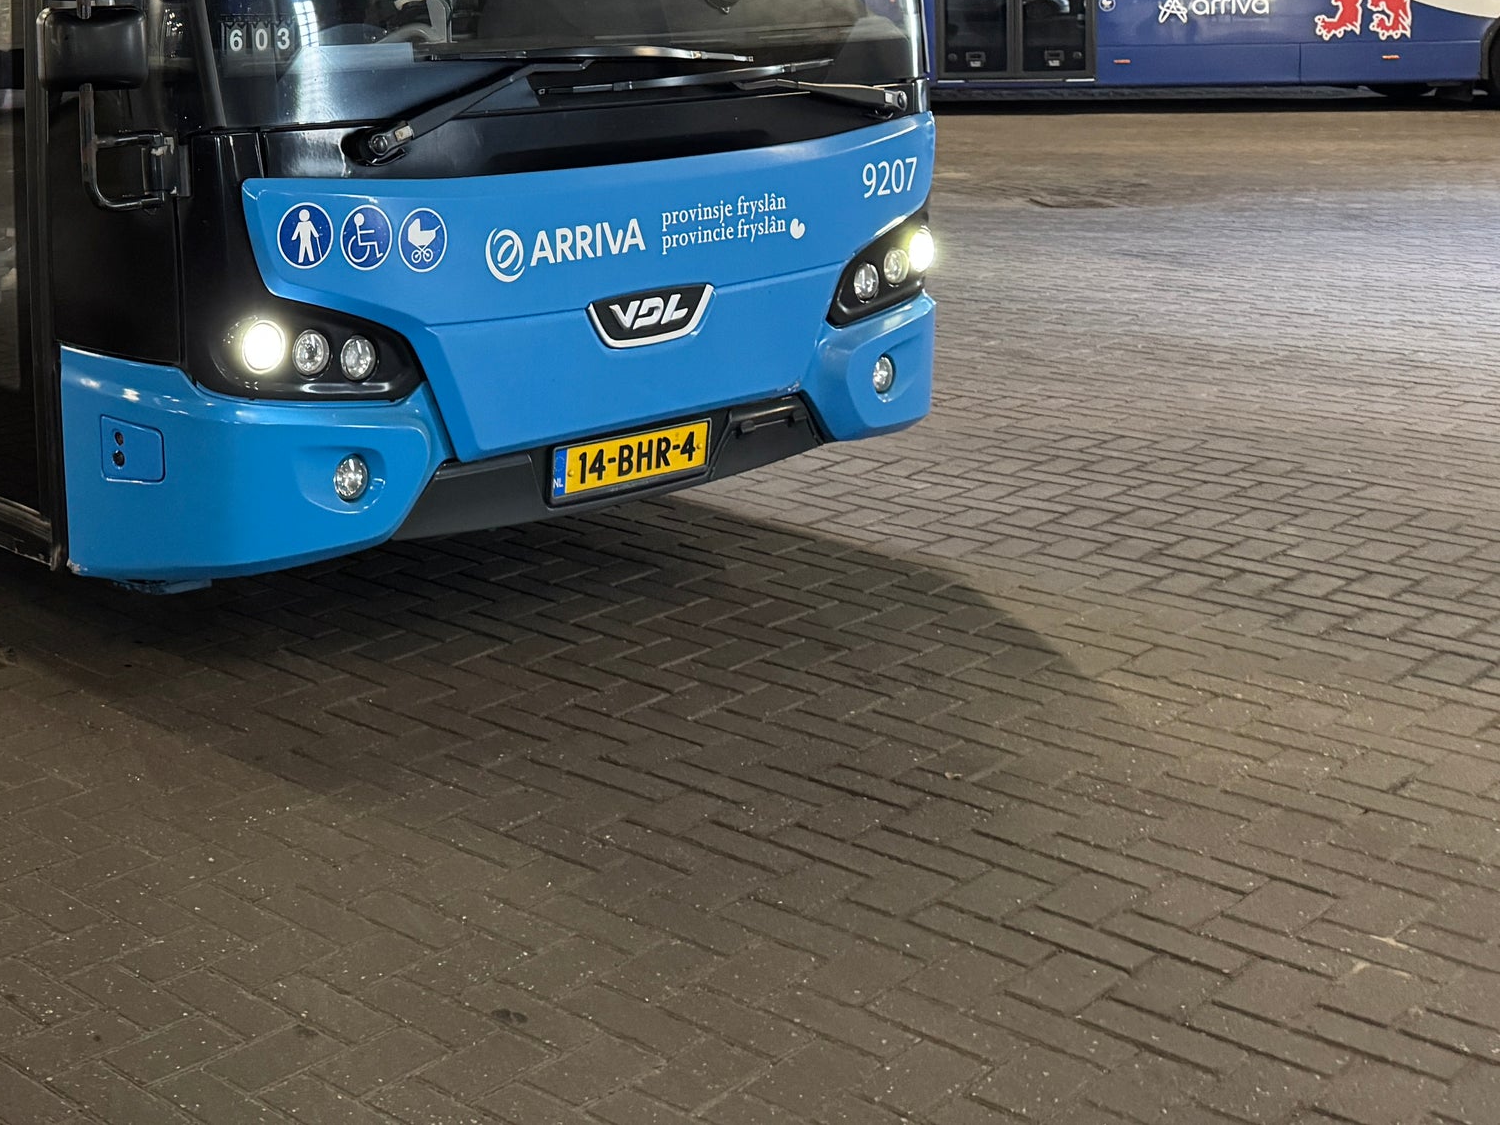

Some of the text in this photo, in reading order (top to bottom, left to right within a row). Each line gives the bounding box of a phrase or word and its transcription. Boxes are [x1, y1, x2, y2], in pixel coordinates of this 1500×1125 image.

[862, 156, 917, 199] 9207
[662, 193, 787, 231] provinsje fryslân
[530, 218, 646, 267] ARRIVA
[662, 216, 787, 255] provincie fryslân
[609, 293, 689, 331] VDL
[579, 431, 696, 485] 14-BHR-4
[553, 477, 564, 488] NL
